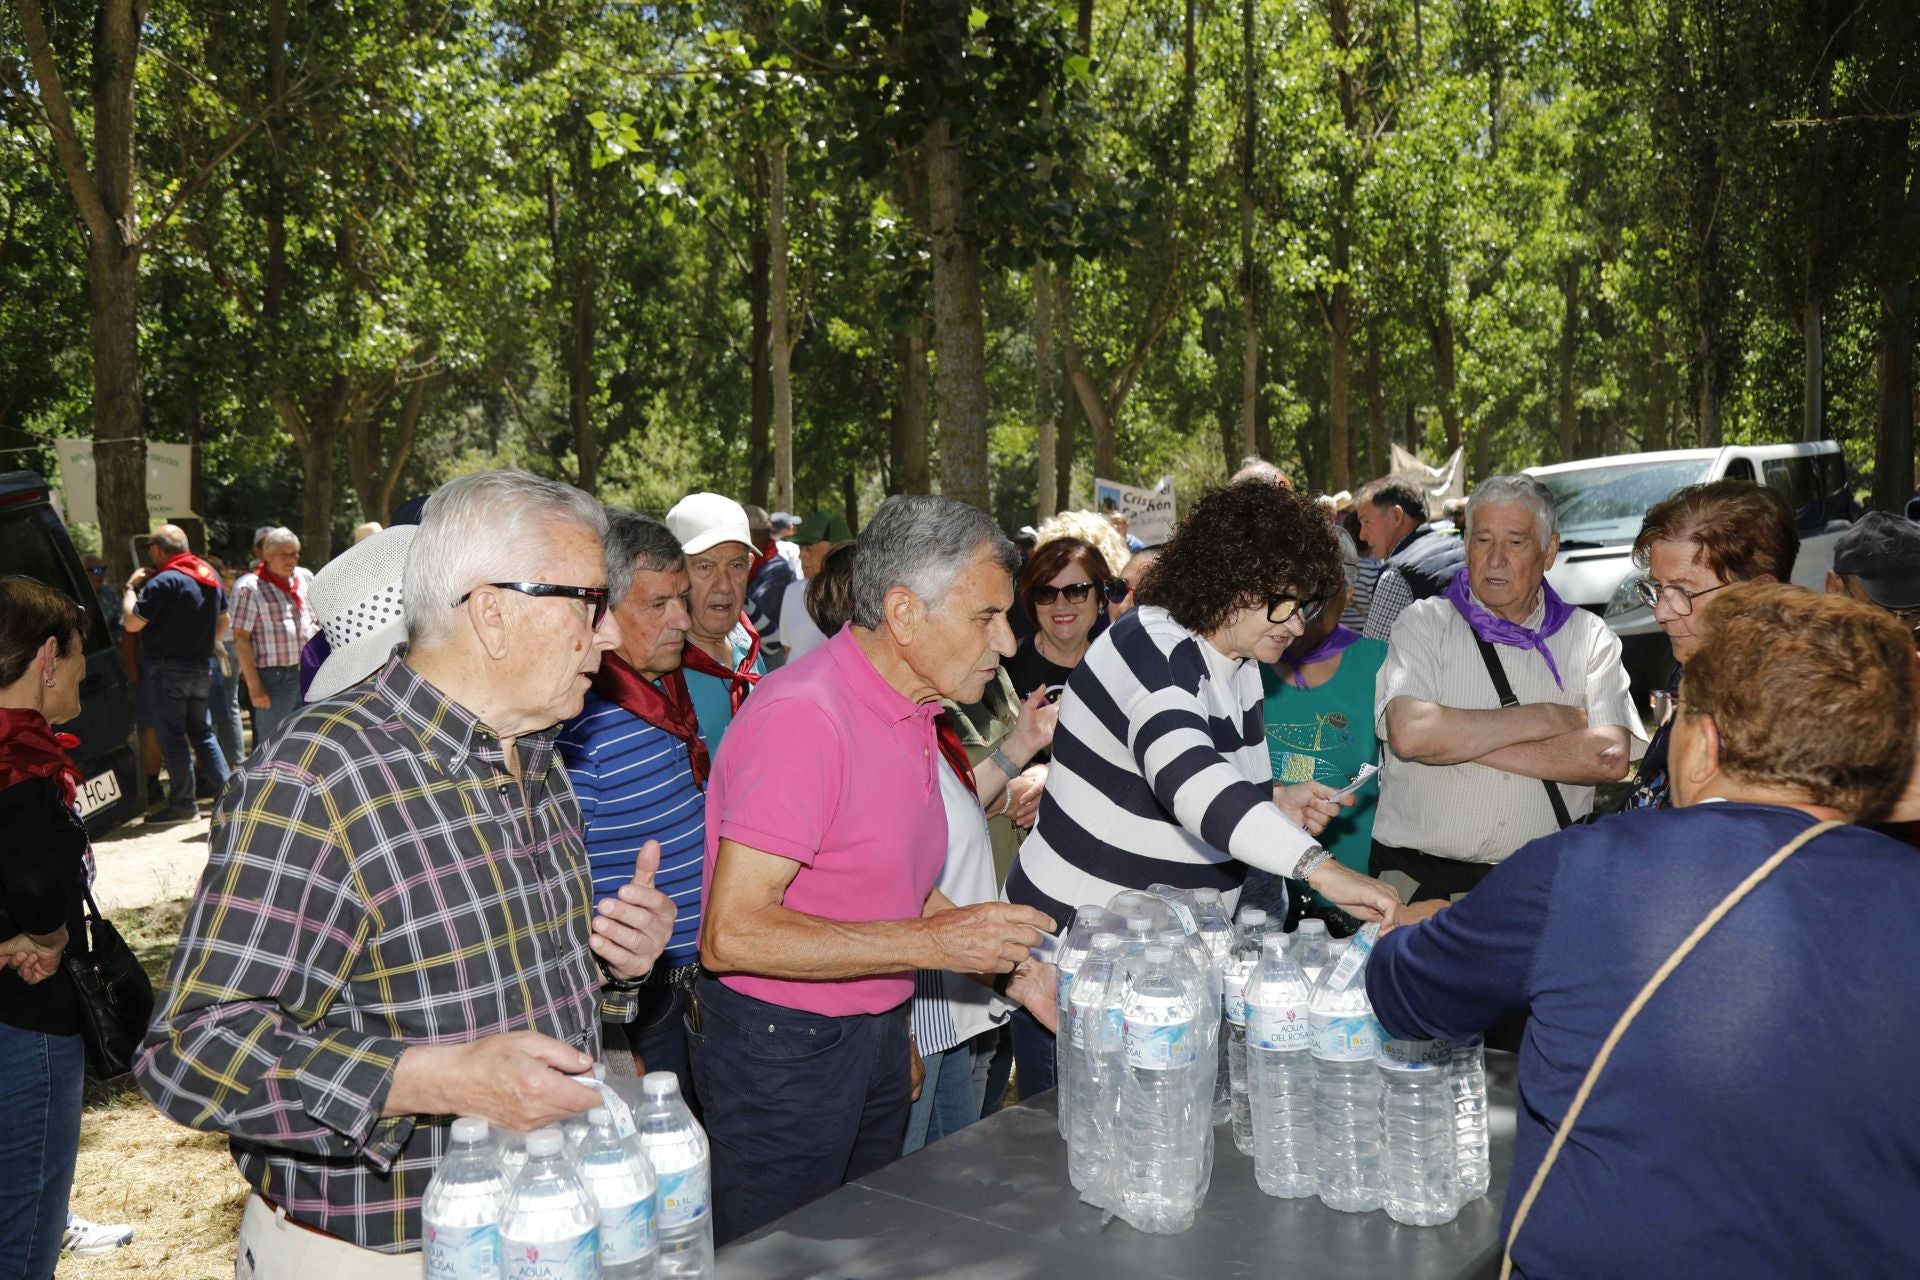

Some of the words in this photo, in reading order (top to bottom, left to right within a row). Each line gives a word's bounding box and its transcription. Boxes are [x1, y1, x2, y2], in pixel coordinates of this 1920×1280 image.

[83, 774, 117, 809] HCJ
[1281, 1023, 1304, 1033] AGUA
[1271, 1033, 1286, 1041] DEL
[1288, 1031, 1309, 1041] ROSA
[519, 1266, 552, 1278] AGUA
